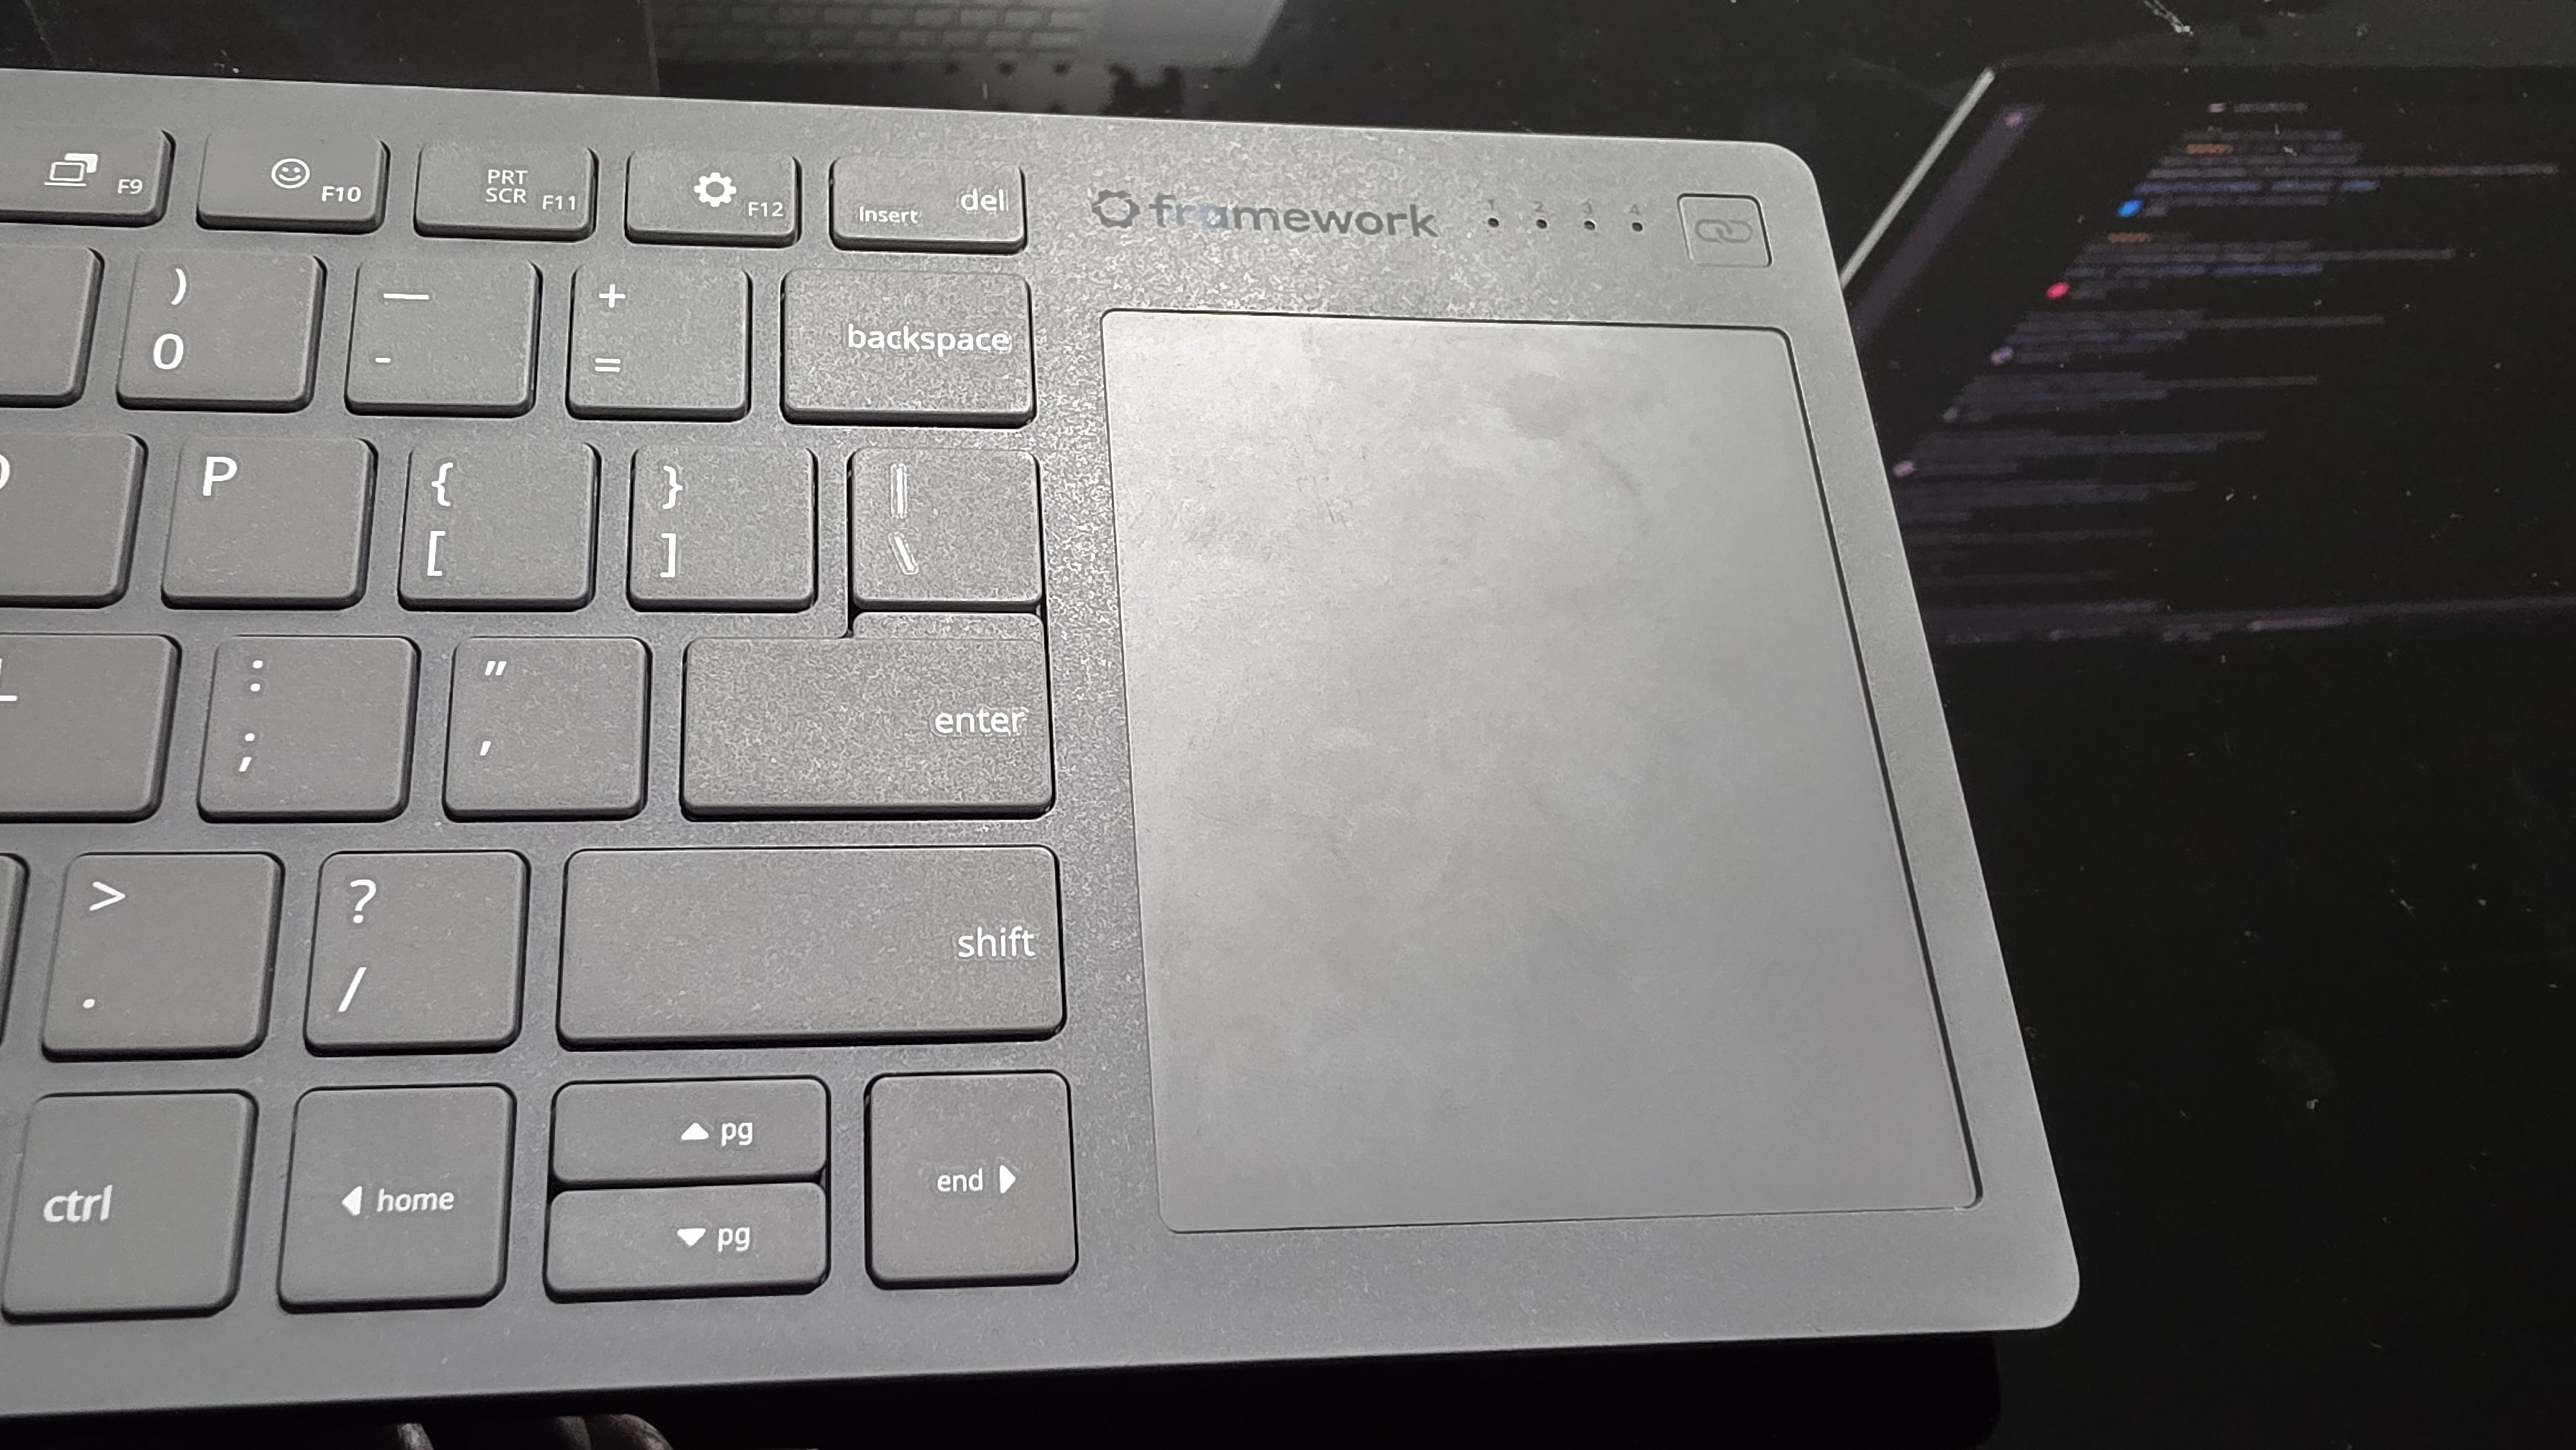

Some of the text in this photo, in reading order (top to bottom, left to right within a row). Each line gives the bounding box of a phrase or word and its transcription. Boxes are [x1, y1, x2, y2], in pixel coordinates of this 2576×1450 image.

[117, 179, 142, 194] F9
[488, 169, 528, 185] PRT
[321, 185, 361, 202] F10
[486, 187, 527, 204] SCR
[542, 194, 576, 211] F11
[960, 188, 1005, 211] del
[1533, 201, 1544, 212] 2
[1582, 199, 1593, 214] 3
[748, 201, 784, 218] F12
[1149, 194, 1439, 238] framework
[171, 268, 187, 305] )
[598, 284, 627, 309] +
[153, 333, 184, 370] 0
[848, 323, 1011, 358] backspace
[594, 357, 621, 373] =
[202, 456, 238, 496] P
[431, 462, 454, 507] {
[661, 465, 684, 510] }
[426, 530, 446, 577] [
[659, 532, 677, 578] ]
[891, 534, 917, 572] \
[251, 659, 263, 692] :
[935, 706, 1027, 736] enter
[238, 732, 256, 773] ;
[89, 881, 126, 911] >
[350, 878, 377, 924] ?
[958, 926, 1036, 958] shift
[337, 966, 367, 1013] /
[721, 1122, 753, 1147] pg
[936, 1168, 983, 1192] end
[43, 1185, 113, 1223] ctrl
[377, 1188, 455, 1212] home
[717, 1227, 750, 1252] pg
